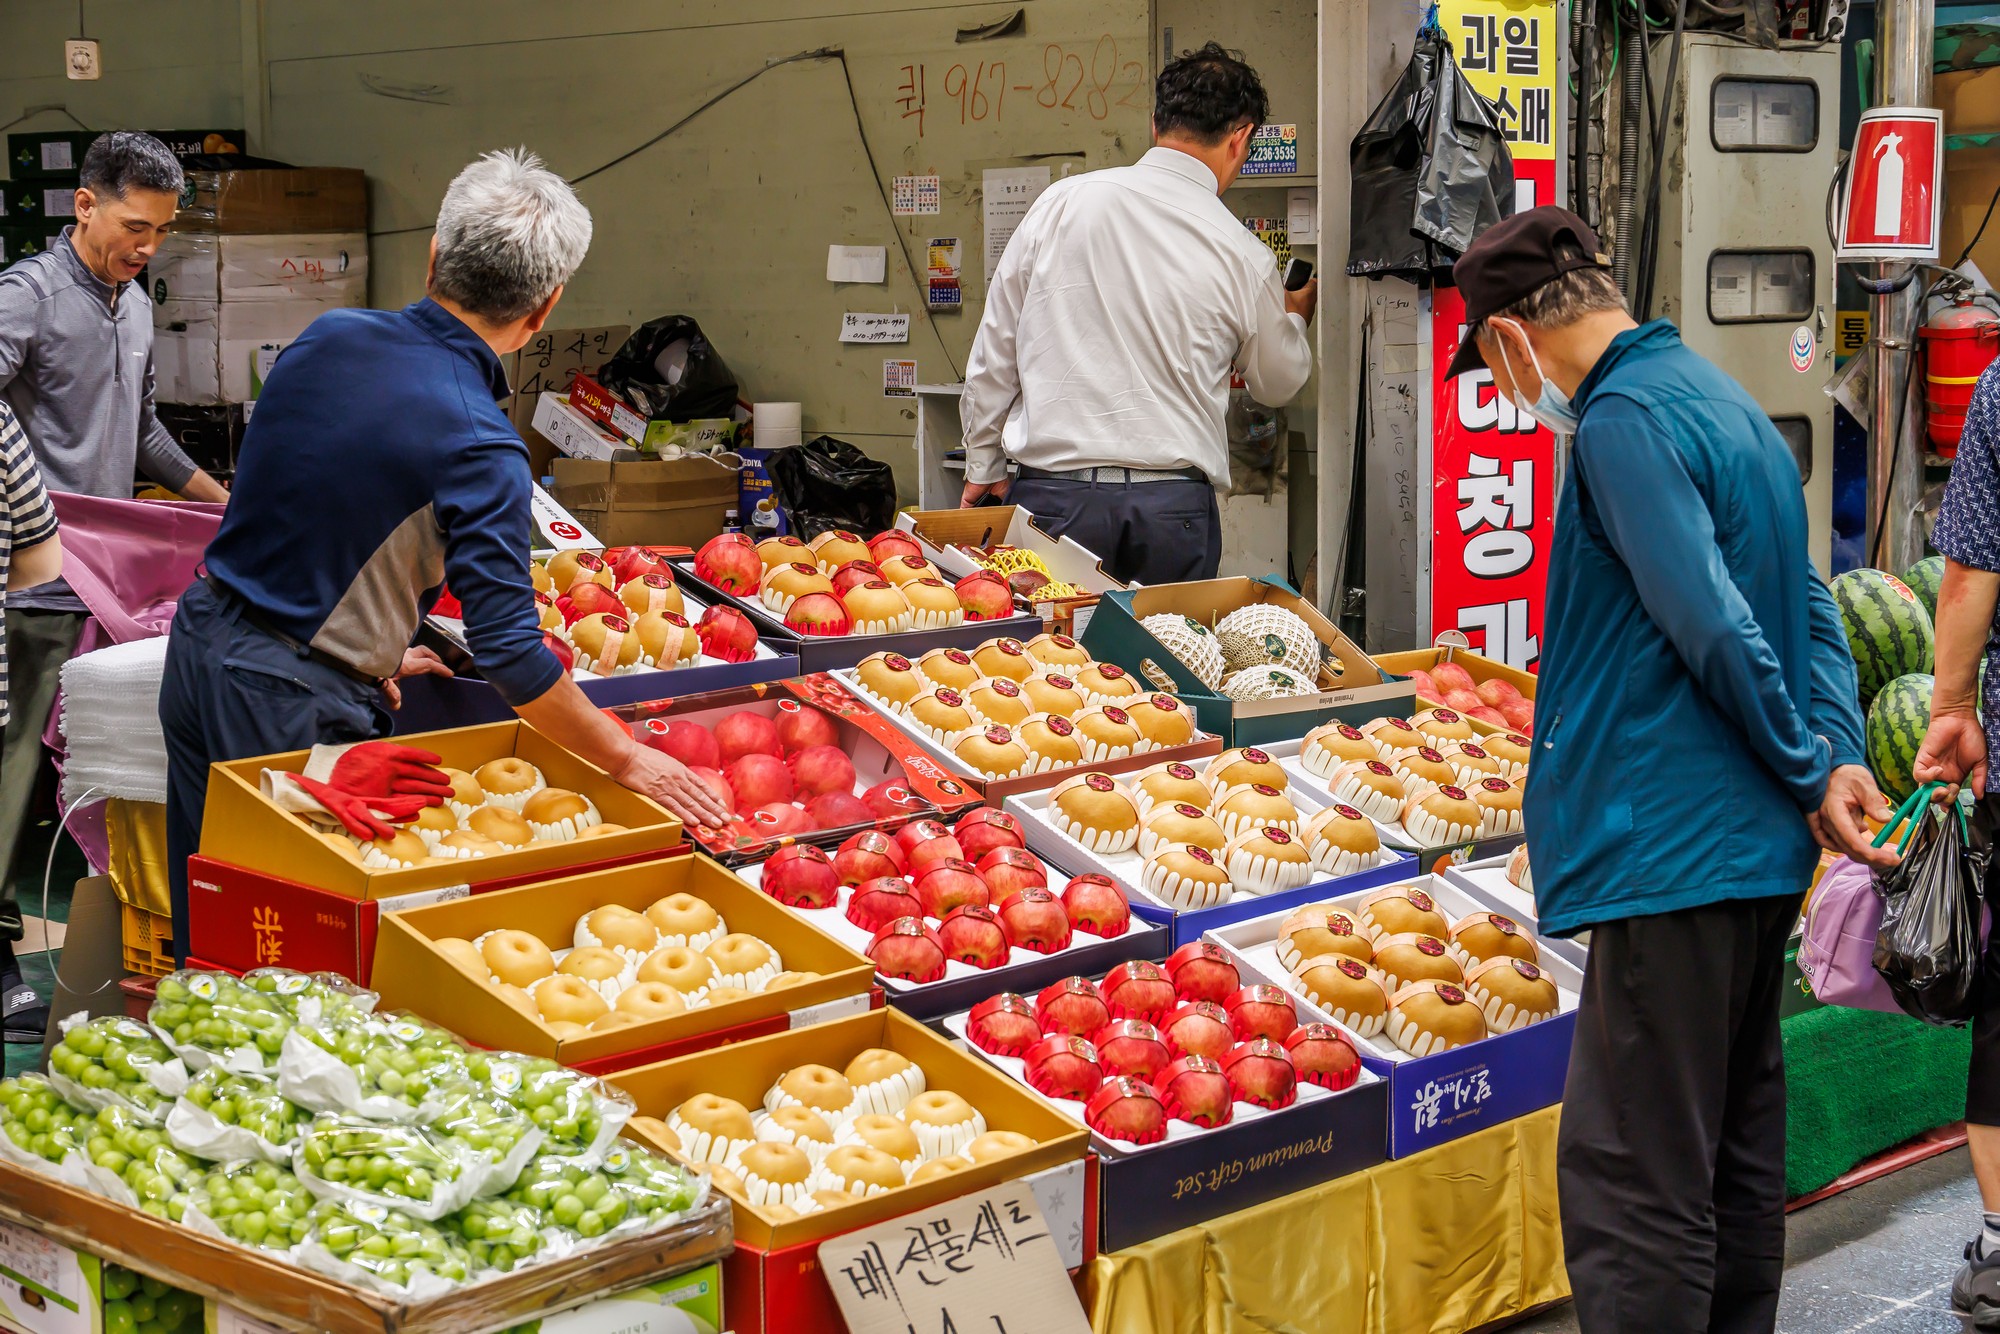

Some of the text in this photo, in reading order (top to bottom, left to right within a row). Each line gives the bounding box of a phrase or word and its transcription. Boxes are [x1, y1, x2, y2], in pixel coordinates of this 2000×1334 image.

[1461, 15, 1539, 75] 과일
[945, 34, 1149, 121] 967-8282
[1282, 127, 1295, 138] A/S
[1498, 86, 1550, 144] 소매
[525, 334, 556, 368] 왕
[1171, 1130, 1334, 1200] Premium Gift Set
